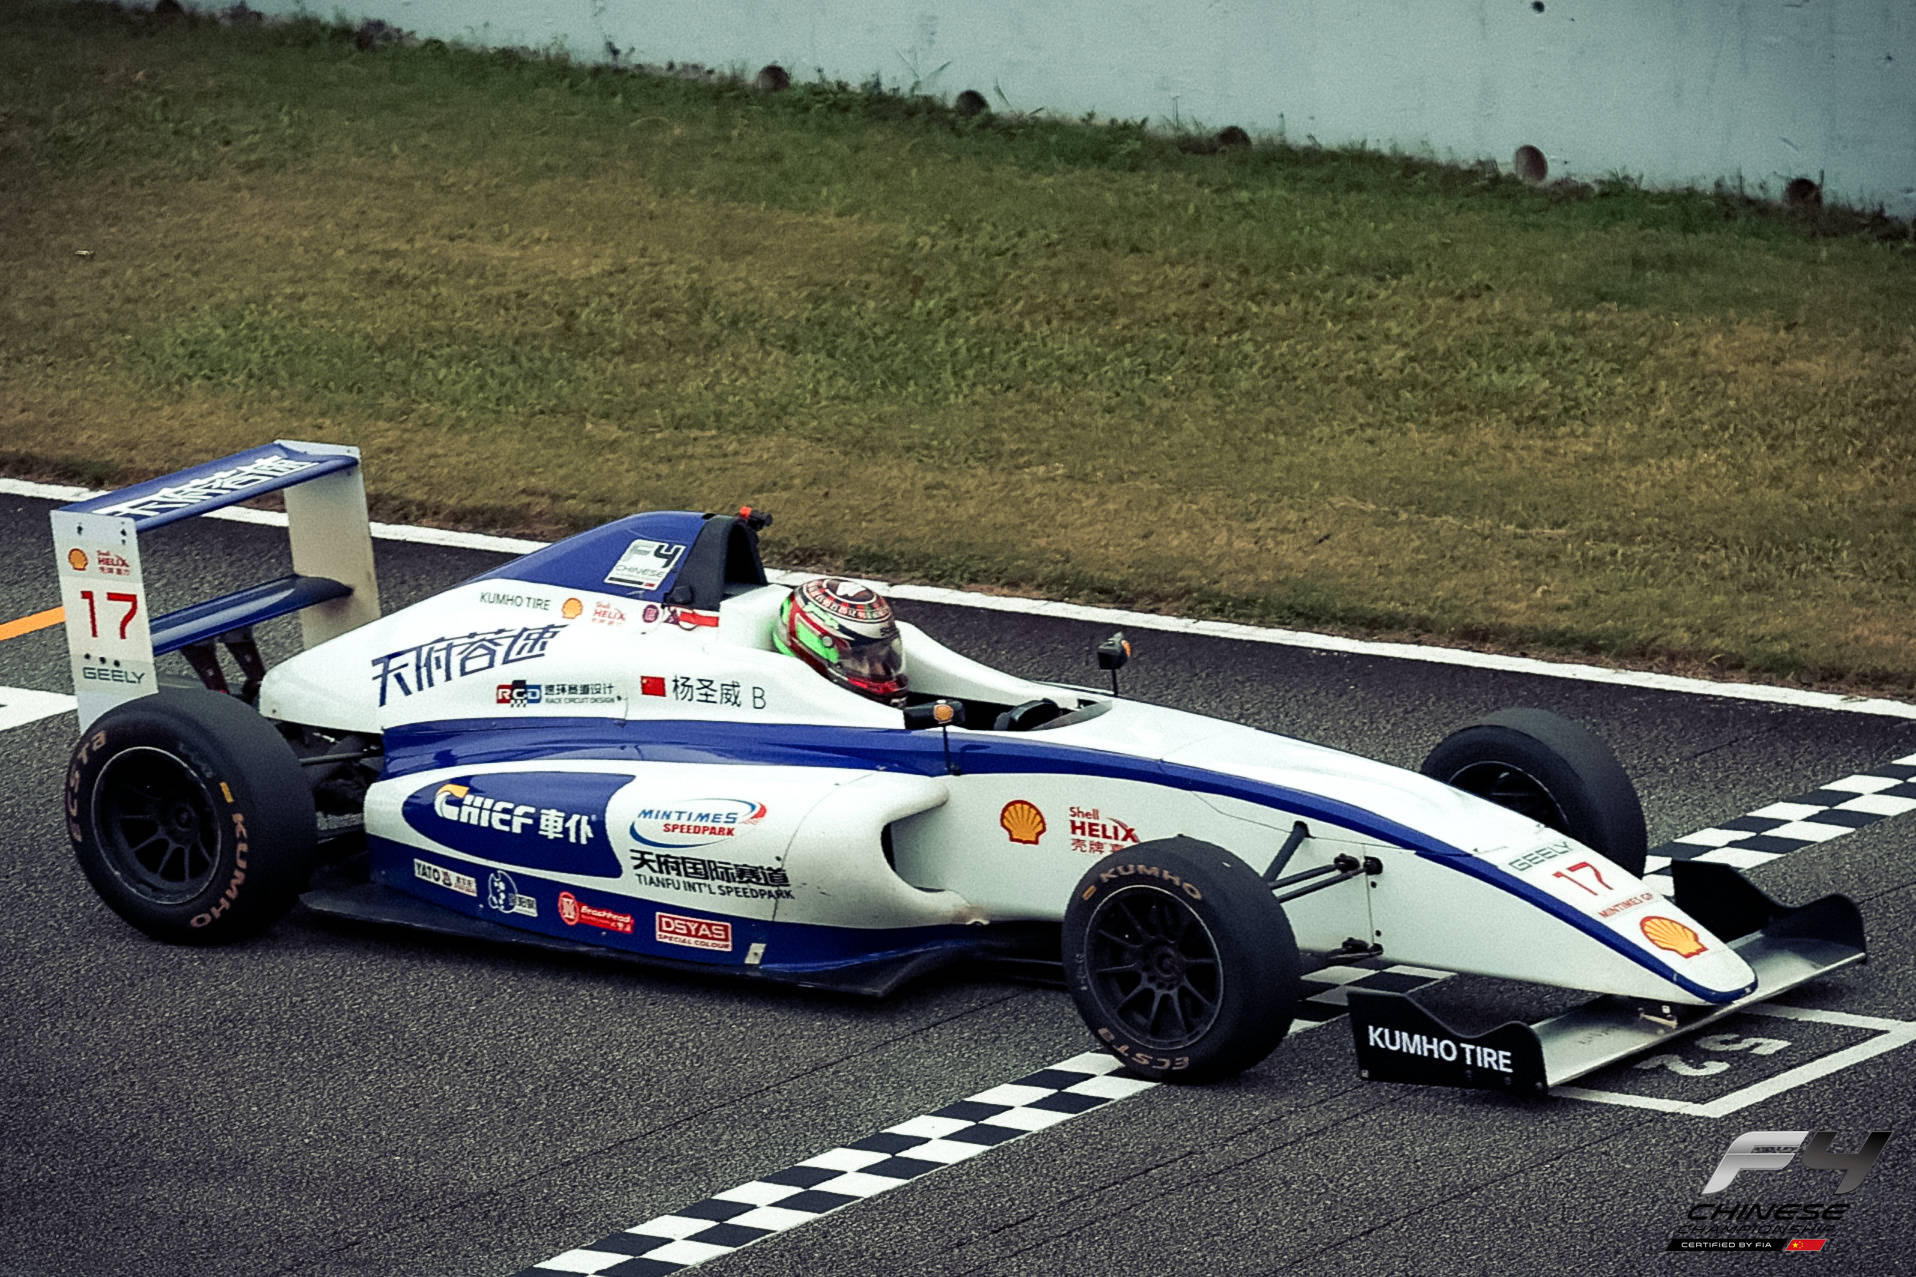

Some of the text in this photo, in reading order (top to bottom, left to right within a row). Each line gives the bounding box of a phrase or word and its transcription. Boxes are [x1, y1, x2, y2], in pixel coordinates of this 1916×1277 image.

[625, 543, 683, 569] F4
[615, 564, 665, 578] CHINESE
[480, 592, 551, 611] KUMHO TIRE
[81, 590, 138, 640] 17
[82, 666, 145, 684] GEELY
[497, 685, 541, 702] RCD
[672, 674, 767, 709] 杨圣威 B
[434, 784, 537, 834] CHIEF
[637, 808, 739, 825] MINTIMES
[1069, 805, 1100, 820] Shell
[663, 822, 737, 838] SPEEDPARK
[1069, 817, 1141, 844] HELIX
[629, 849, 791, 888] 天府国际赛道
[1508, 841, 1574, 872] GEELY
[190, 812, 249, 929] KUMHO
[414, 861, 442, 883] YATO
[1099, 863, 1203, 901] KUMHO
[1552, 861, 1615, 897] 17
[635, 873, 796, 900] TIANFU INT'L SPEEDPARK
[657, 933, 730, 950] SPECIAL COLOUR
[660, 917, 727, 940] DSYAS
[1367, 1024, 1514, 1073] KUMHO TIRE
